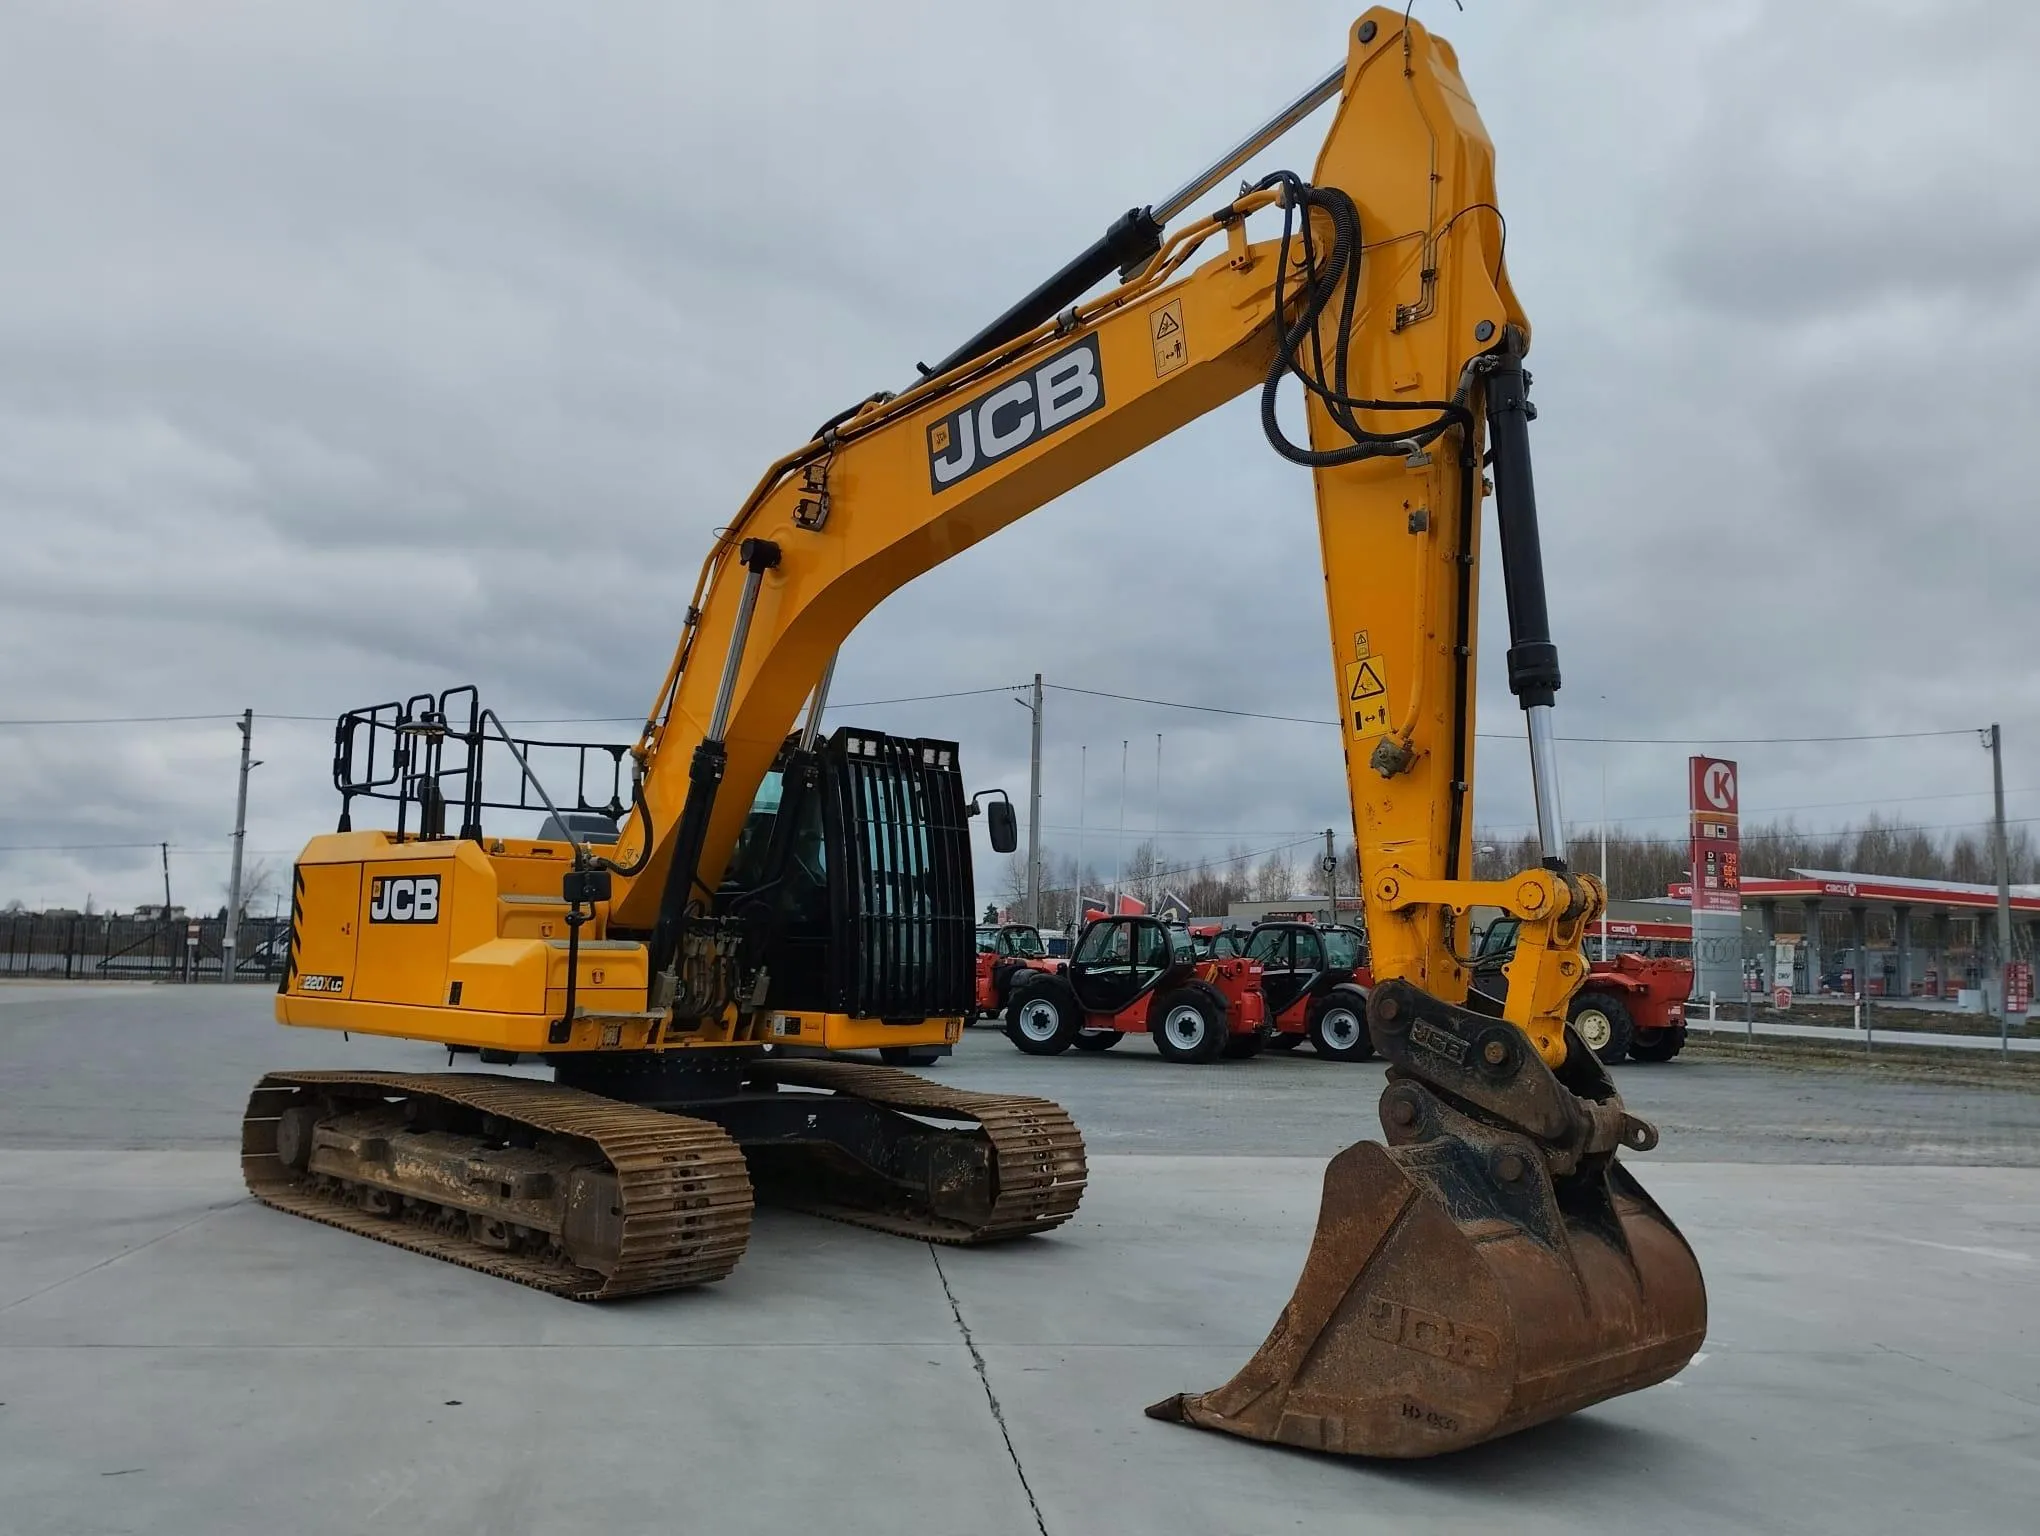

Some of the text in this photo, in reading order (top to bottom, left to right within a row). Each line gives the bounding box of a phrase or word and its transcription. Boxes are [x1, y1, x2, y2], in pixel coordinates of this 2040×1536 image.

[934, 347, 1099, 483] JCB
[371, 879, 438, 920] JCB
[1678, 886, 1693, 895] CIR
